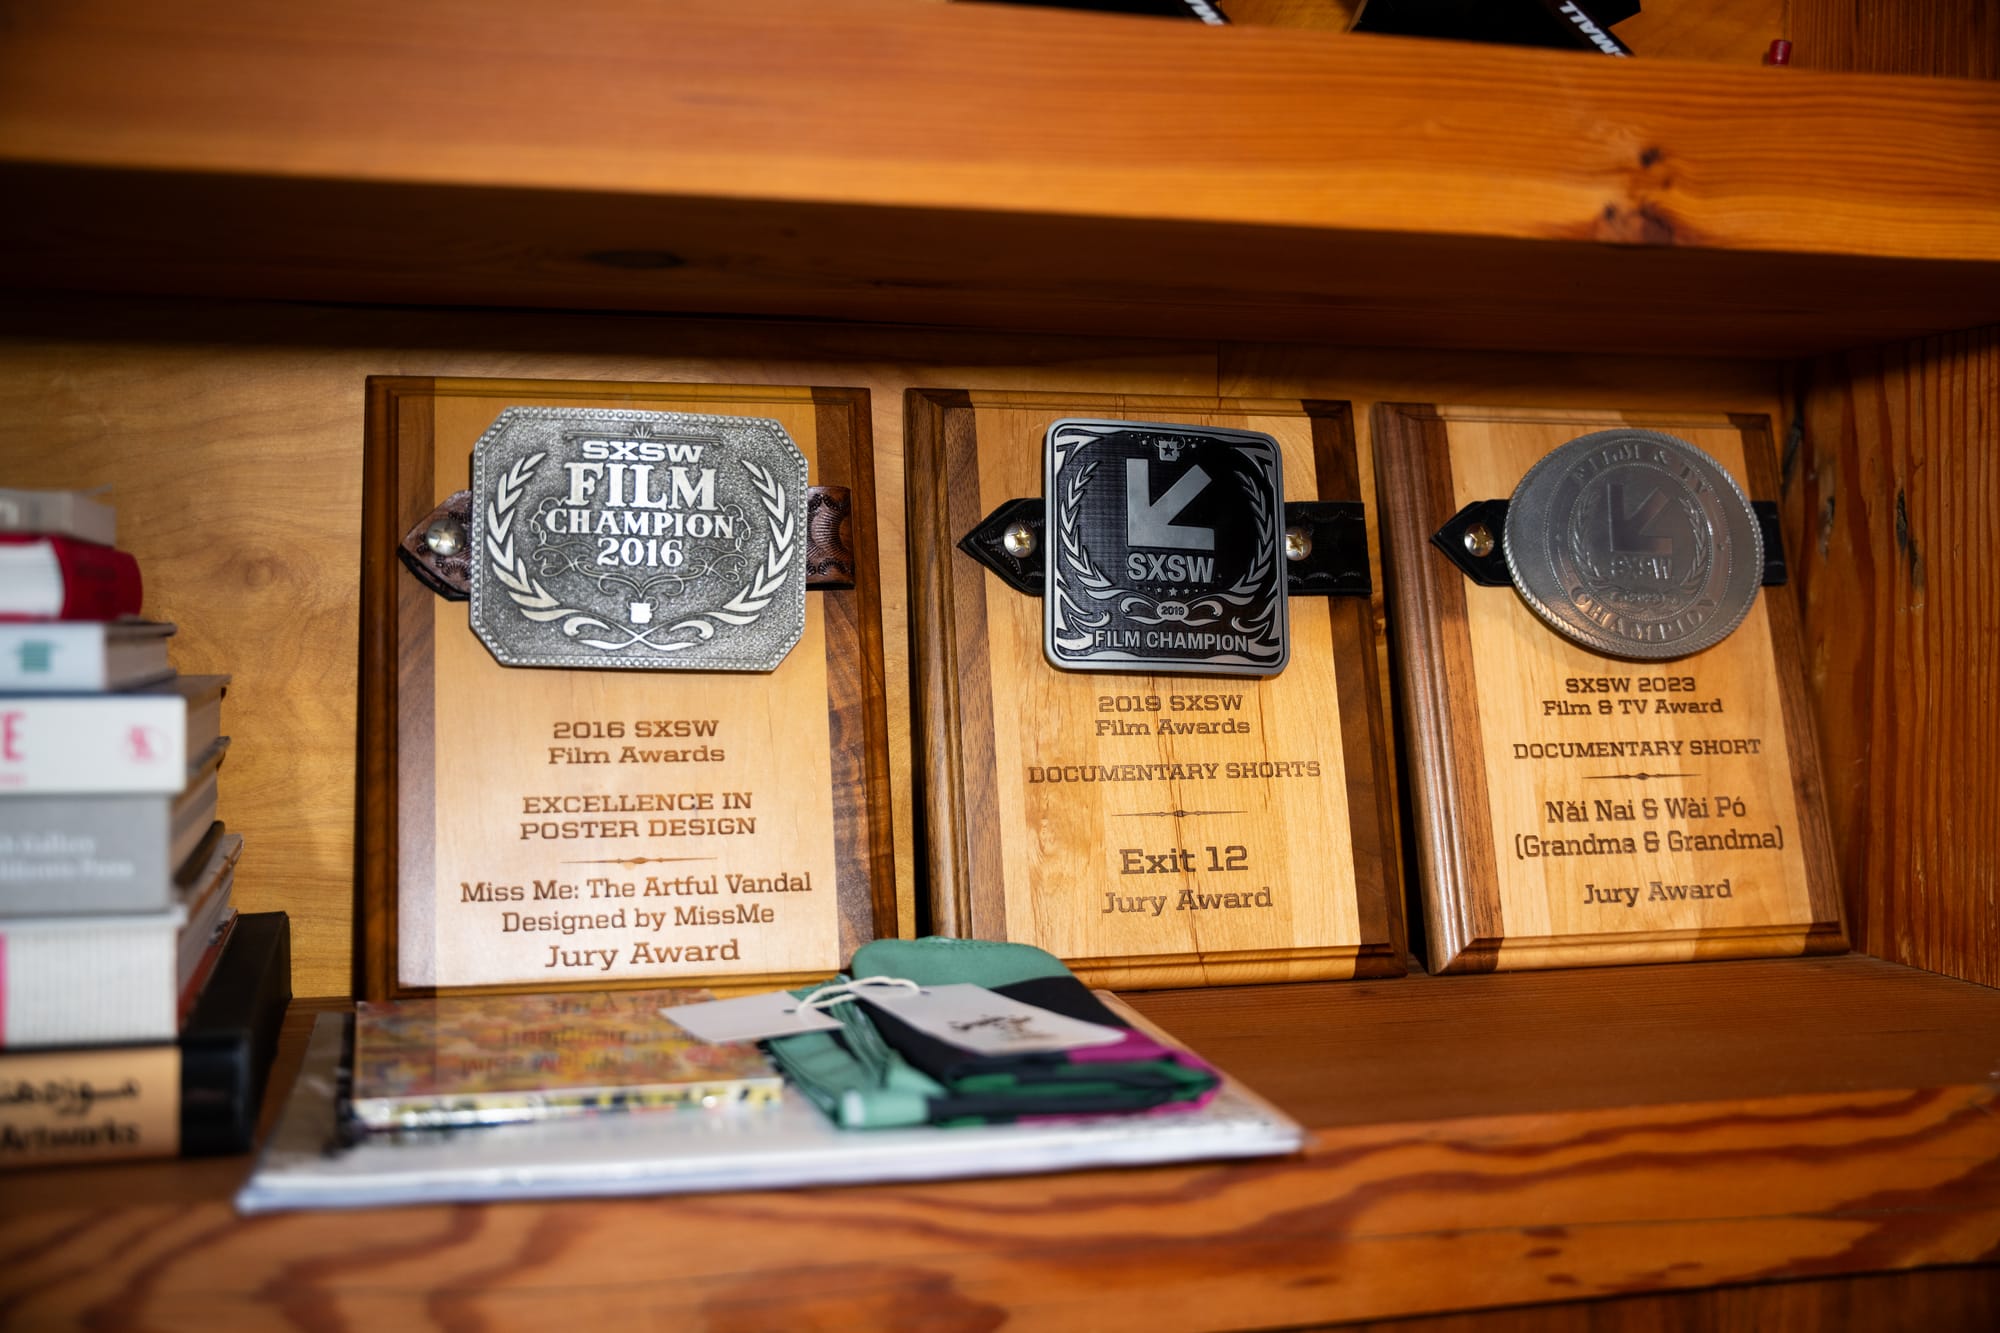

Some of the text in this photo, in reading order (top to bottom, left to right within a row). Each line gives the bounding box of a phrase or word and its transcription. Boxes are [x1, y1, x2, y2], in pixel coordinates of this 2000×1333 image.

[582, 440, 704, 463] SXSW
[564, 462, 719, 512] FILM
[545, 508, 736, 539] CHAMPION
[596, 536, 684, 568] 2016
[1126, 552, 1215, 585] SXSW
[1160, 605, 1185, 616] 2019
[1094, 629, 1248, 653] FILM CHAMPION
[1565, 677, 1696, 693] SXSW 2023
[1098, 694, 1243, 713] 2019 SXSW
[1542, 698, 1724, 716] Film & TV Award
[553, 720, 719, 739] 2016 SXSW
[1095, 718, 1250, 737] Film Awards
[548, 745, 726, 764] Film Awards
[1513, 738, 1761, 759] DOCUMENTARY SHORT
[1029, 761, 1321, 783] DOCUMENTARY SHORTS
[522, 792, 753, 814] EXCELLENCE IN
[1595, 799, 1635, 821] Nai
[1642, 799, 1658, 820] &
[520, 817, 757, 840] POSTER DESIGN
[1515, 825, 1784, 860] (Grandma & Grandma)
[1120, 845, 1249, 874] Exit 12
[460, 872, 812, 902] Miss Me: The Artful Vandal
[1584, 879, 1733, 907] Jury Award
[1102, 887, 1273, 916] Jury Award
[502, 903, 775, 935] Designed by MissMe
[545, 939, 741, 971] Jury Award
